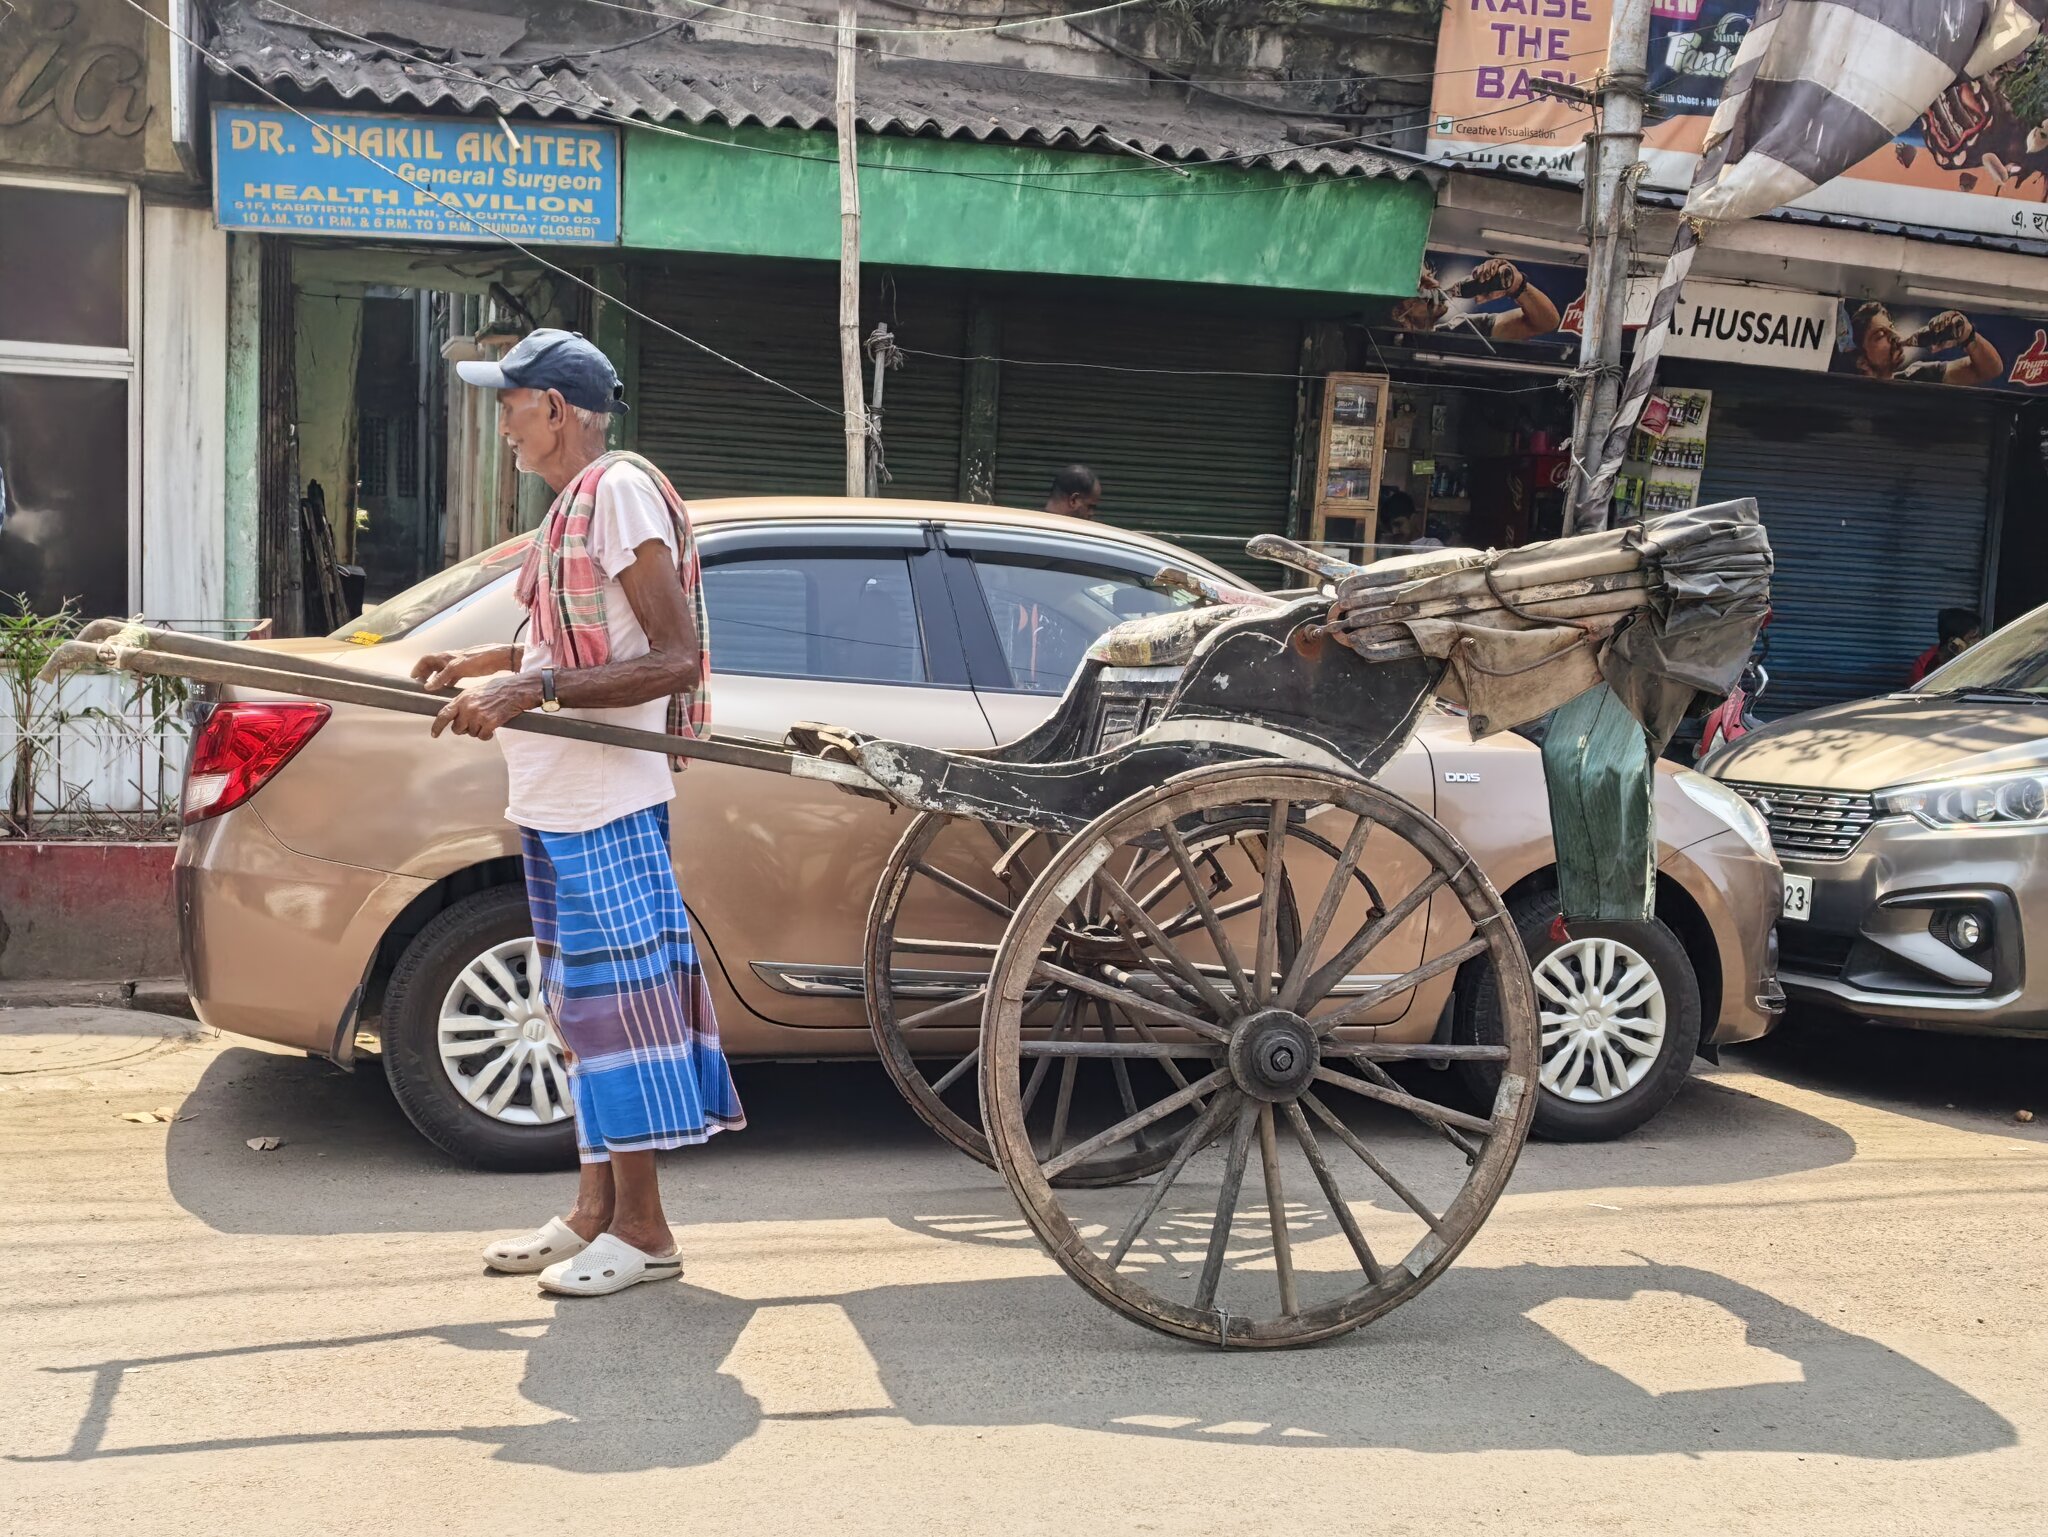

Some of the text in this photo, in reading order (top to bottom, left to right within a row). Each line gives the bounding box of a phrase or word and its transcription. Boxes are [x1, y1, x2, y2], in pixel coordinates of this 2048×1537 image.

[1490, 22, 1570, 61] THE
[231, 119, 603, 172] DR. SHAKIL AKHTER
[1456, 123, 1556, 140] Creative Visualisation
[397, 162, 602, 193] General Surgeon
[243, 182, 593, 214] HEALTH PAVILION
[271, 202, 370, 215] KABITIRTHA
[375, 207, 440, 219] SARANI,
[444, 209, 528, 222] CALCUTTA
[541, 214, 569, 223] 700
[243, 212, 258, 223] 10
[262, 213, 292, 225] A.M.
[295, 214, 313, 225] TO
[329, 215, 356, 227] P.M.
[360, 216, 370, 228] &
[374, 217, 382, 228] 6
[386, 218, 412, 230] P.M.
[415, 219, 433, 231] TO
[437, 220, 445, 231] 9
[449, 220, 475, 233] P.M.
[540, 224, 595, 239] CLOSED)
[1690, 305, 1825, 351] HUSSAIN
